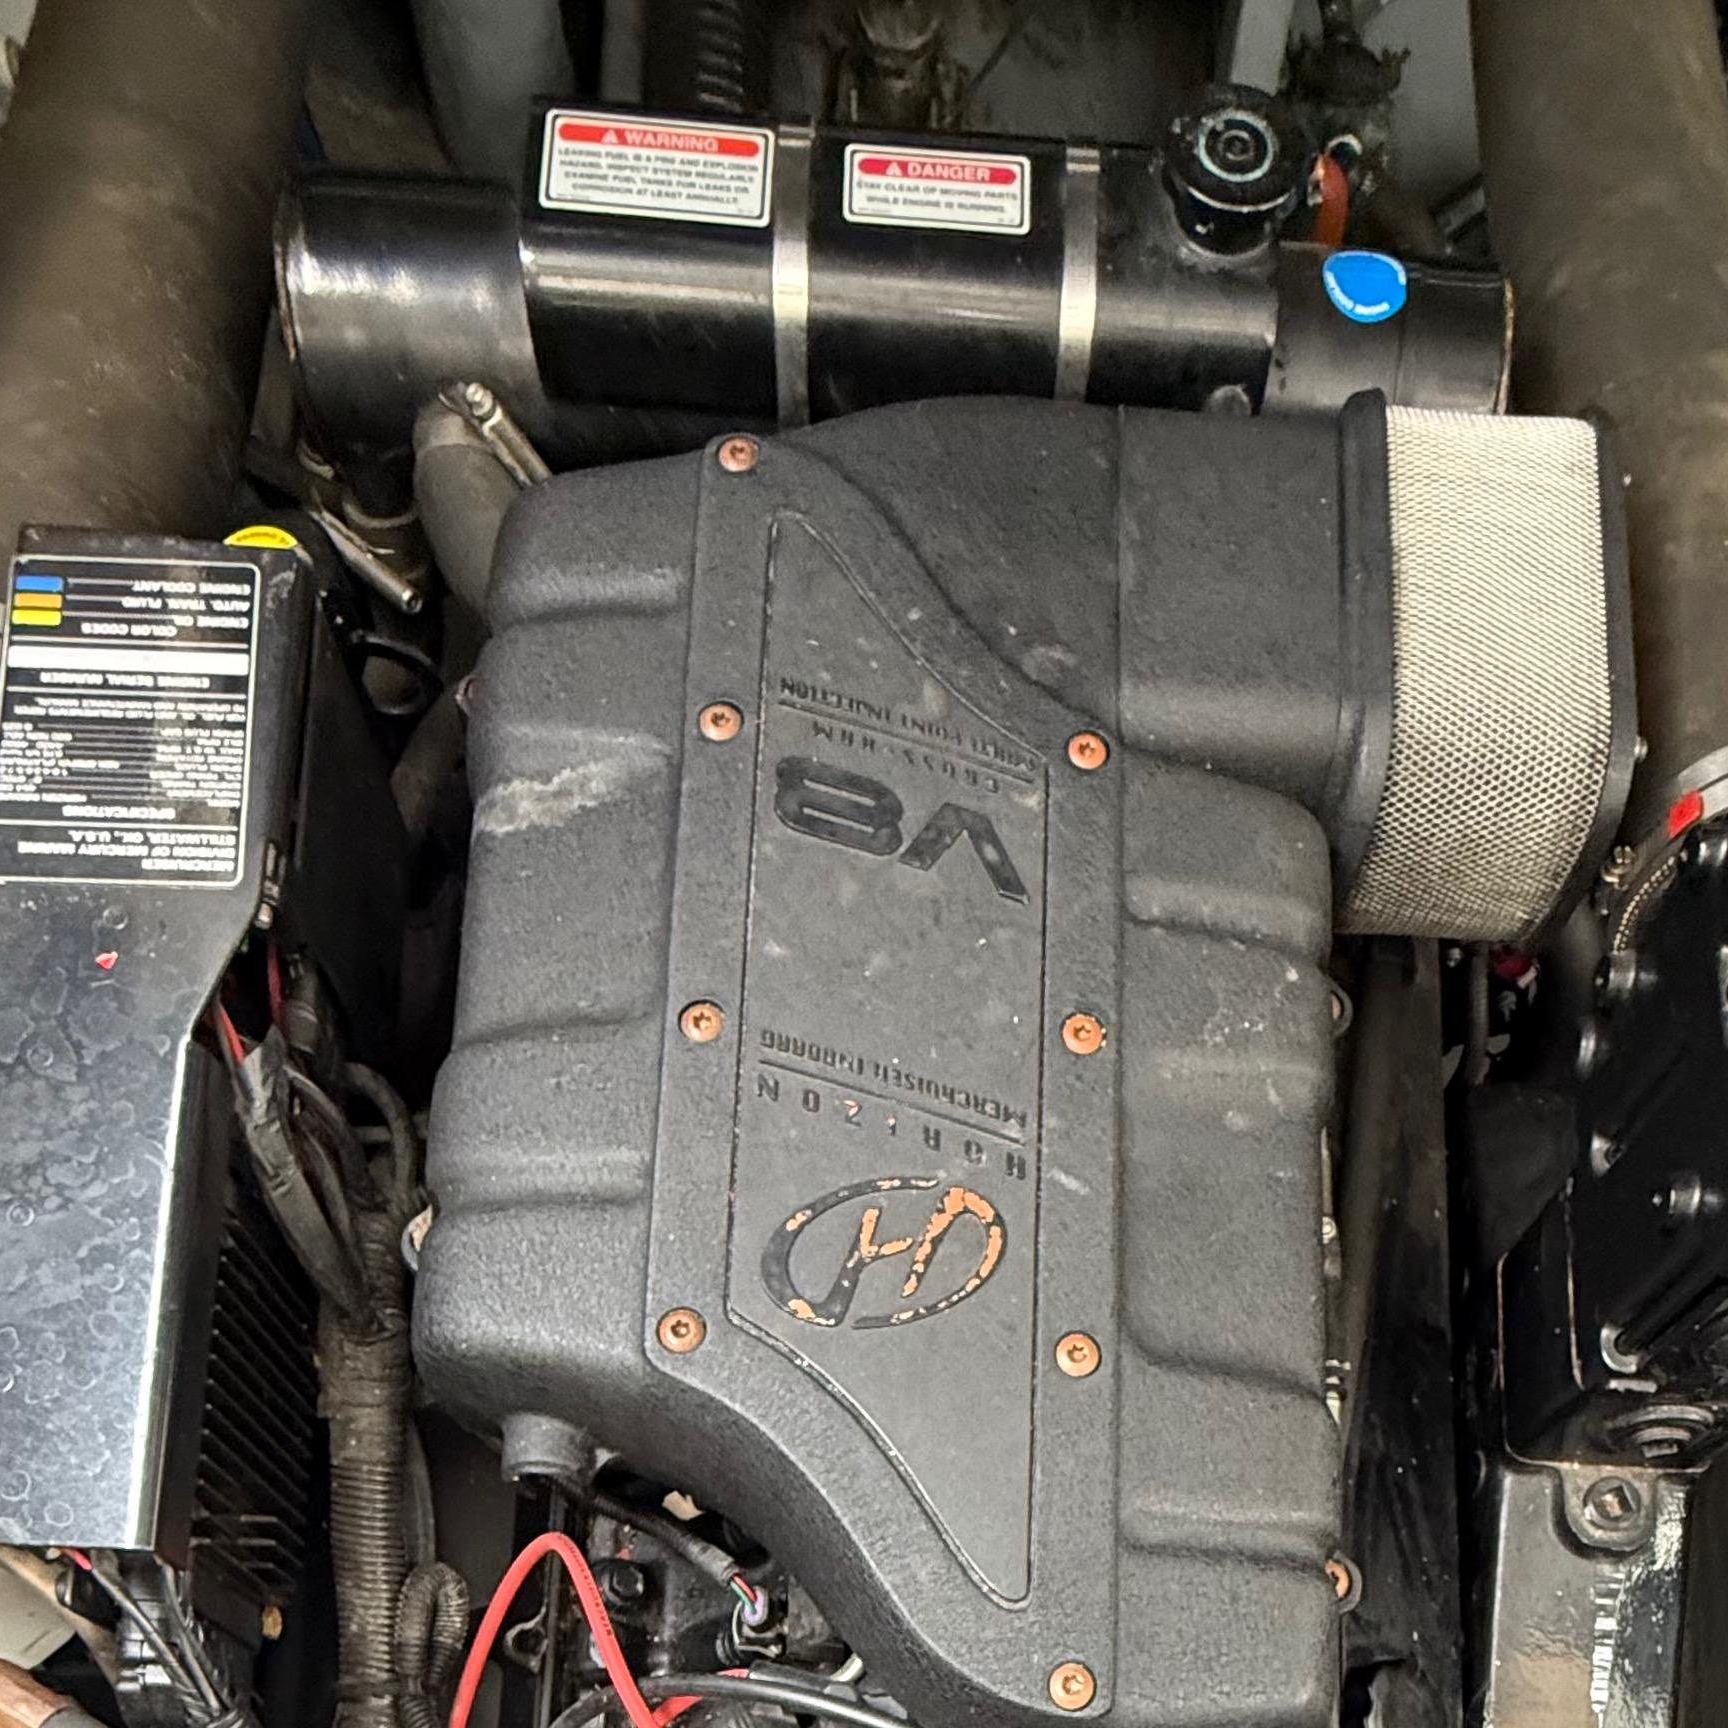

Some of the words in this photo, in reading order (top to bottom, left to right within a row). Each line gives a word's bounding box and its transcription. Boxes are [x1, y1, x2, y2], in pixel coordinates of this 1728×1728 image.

[625, 131, 719, 152] WARNING
[907, 162, 991, 181] DANGER
[774, 754, 1029, 904] V8
